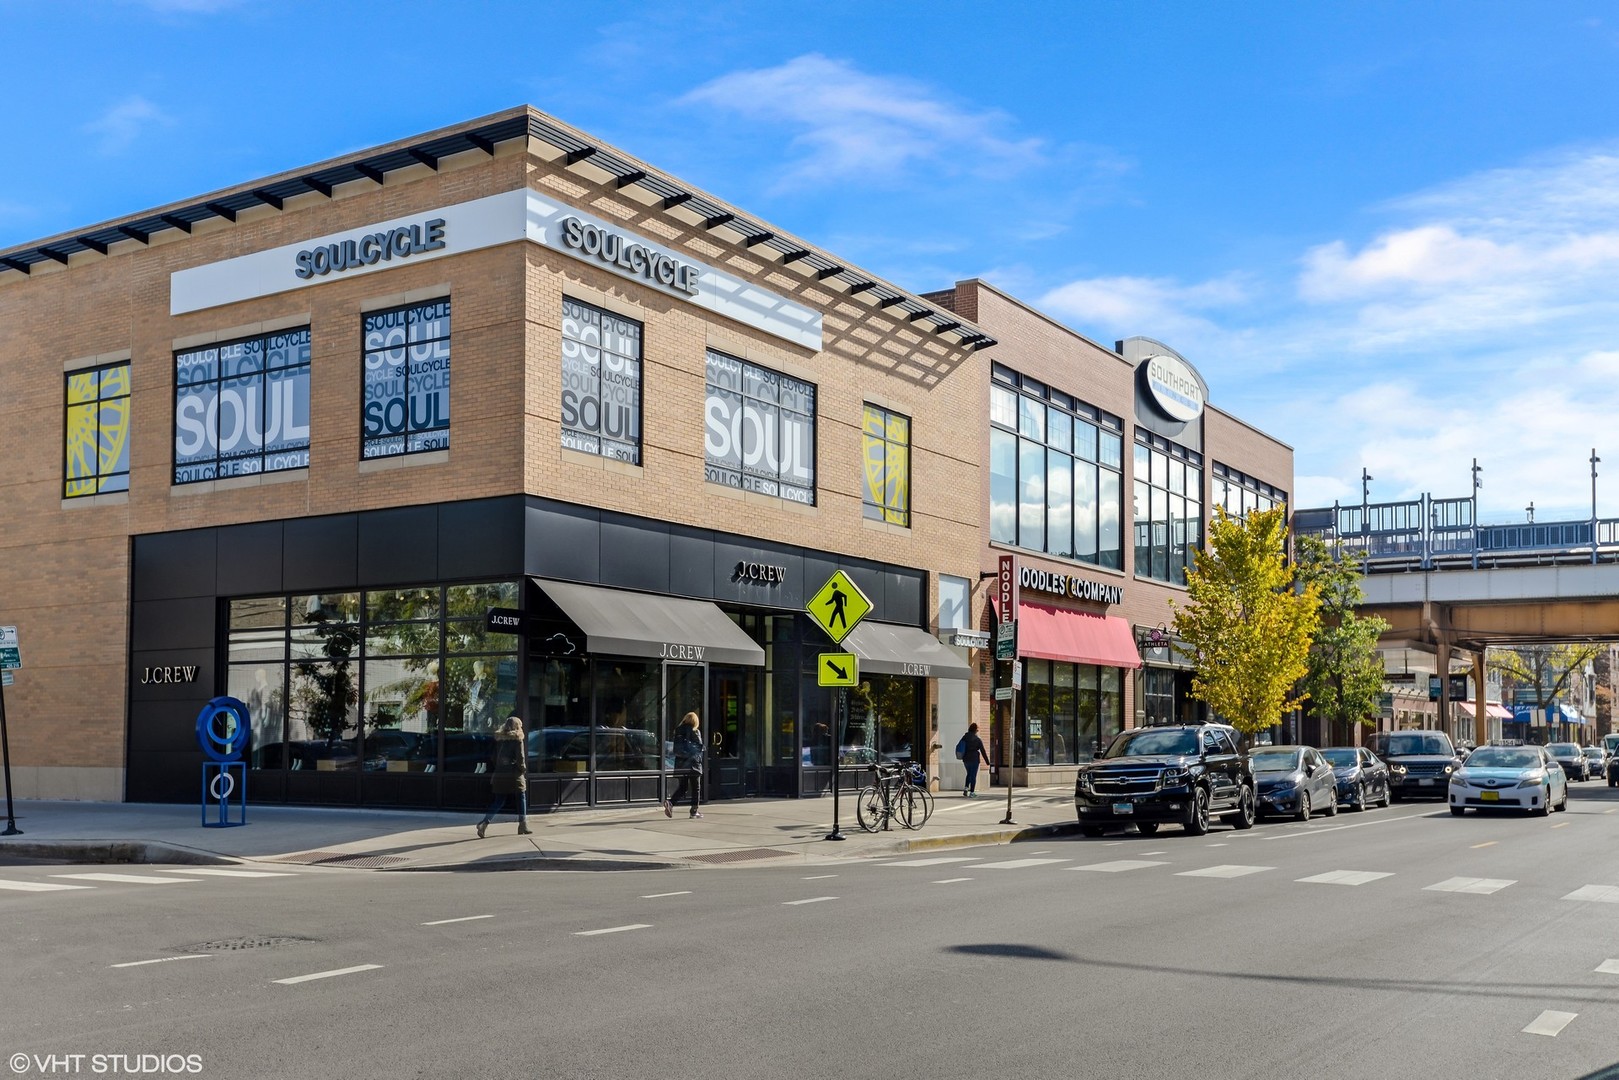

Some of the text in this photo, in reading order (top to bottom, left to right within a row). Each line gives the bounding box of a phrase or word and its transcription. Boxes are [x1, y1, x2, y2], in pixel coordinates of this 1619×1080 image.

[295, 218, 445, 279] SOULCYCLE
[562, 217, 699, 295] SOULCYCLE
[365, 303, 450, 332] SOULCYCLE
[562, 301, 640, 340] SOULCYCLE
[177, 331, 310, 367] SOULCYCLE SOULCYCLE
[365, 320, 450, 370] SOUL
[562, 319, 639, 376] SOUL
[177, 346, 310, 396] SOULCYCLE
[365, 358, 450, 382] CYCLE SOULCYCLE
[562, 358, 640, 389] CYCLE SOULCYCLE
[705, 352, 761, 381] SOULCYCLE
[1151, 362, 1200, 401] SOUTHPORT
[365, 372, 450, 400] SOULCYCLE
[562, 371, 639, 407] SOULCYCLE
[176, 379, 310, 456] SOUL
[365, 392, 449, 437] SOUL
[561, 390, 638, 442] SOUL
[705, 396, 813, 479] SOUL
[176, 454, 310, 483] SOULCYCLE SOULCYCLE
[705, 467, 760, 490] SOULCYCLE
[739, 561, 787, 583] J.CREW
[1002, 561, 1010, 623] NOODLE
[1077, 578, 1124, 604] COMPANY
[491, 615, 520, 626] J.CREW
[660, 643, 705, 660] J.CREW
[141, 666, 196, 684] J.CREW
[901, 663, 931, 677] J.CREW
